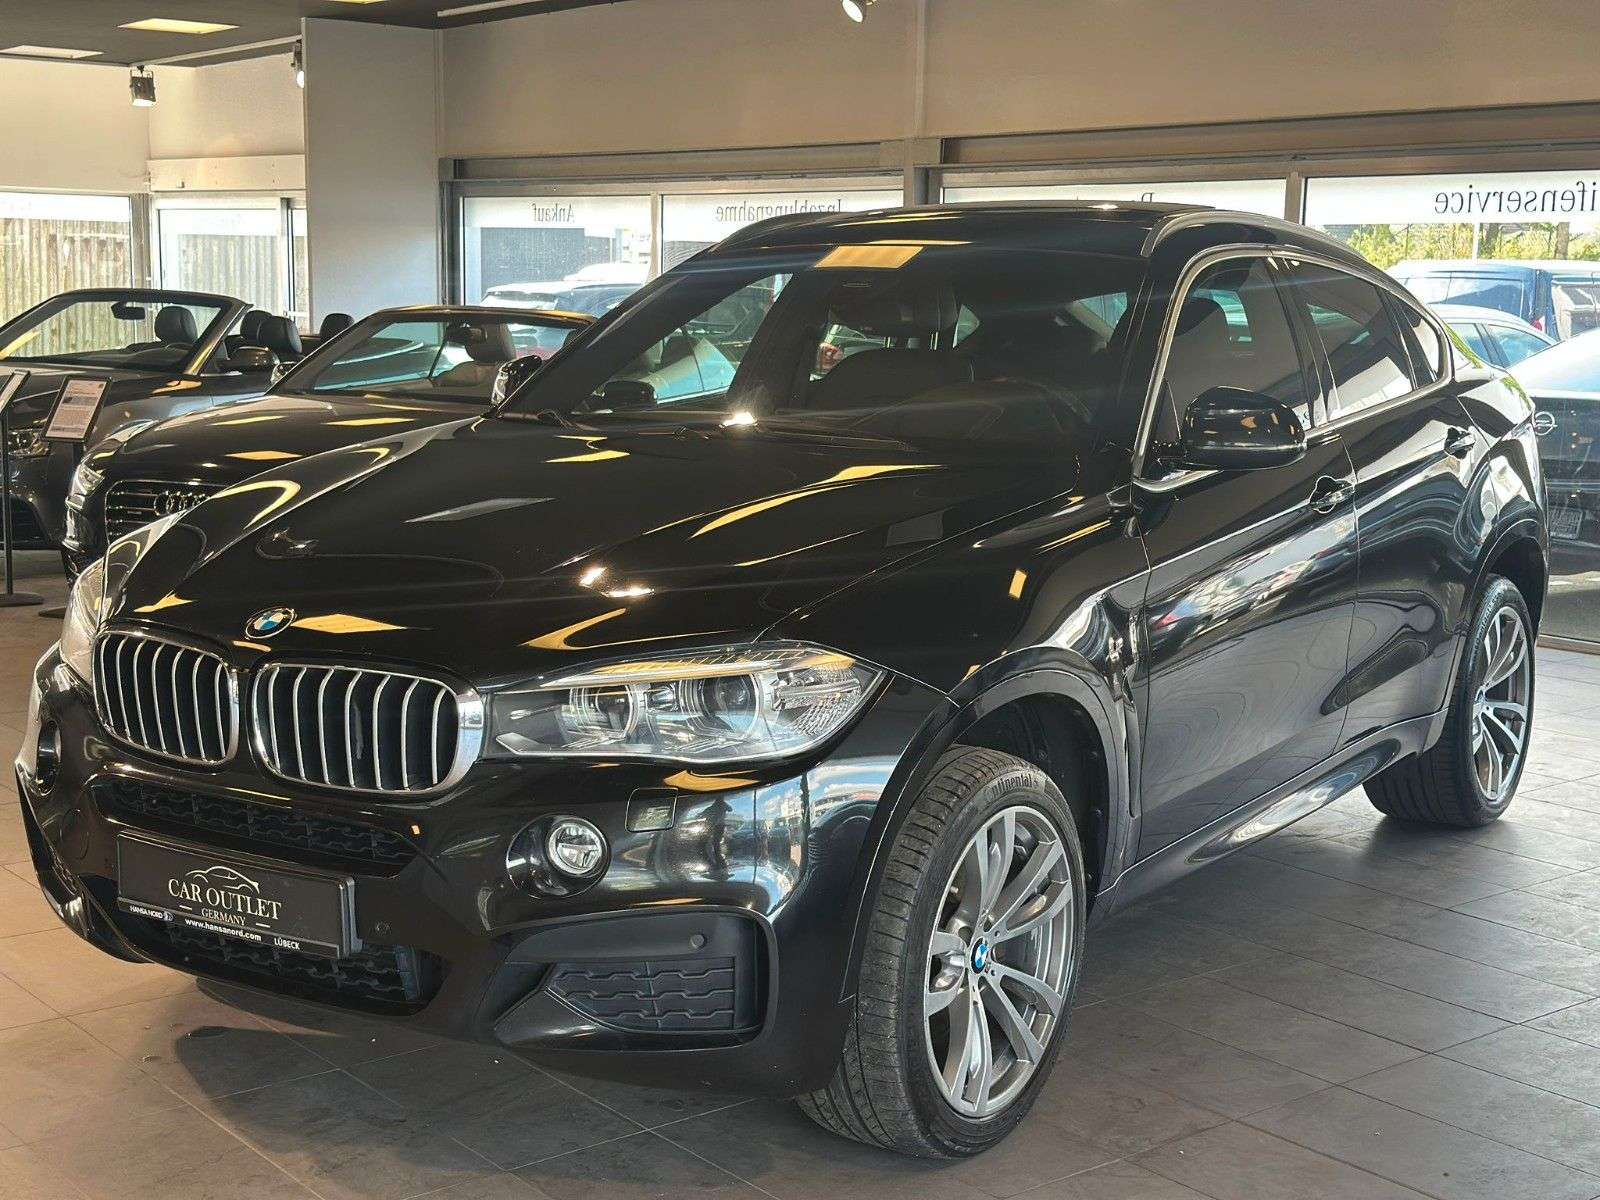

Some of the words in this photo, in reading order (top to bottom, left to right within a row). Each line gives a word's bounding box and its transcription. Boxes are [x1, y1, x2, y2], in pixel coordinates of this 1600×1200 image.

[985, 772, 1034, 802] Cntinental
[168, 878, 203, 903] CAR
[206, 887, 282, 920] OUTLET
[201, 907, 246, 926] GERMANY
[184, 918, 262, 942] www.hansanord.com
[274, 937, 300, 950] LÜBECK
